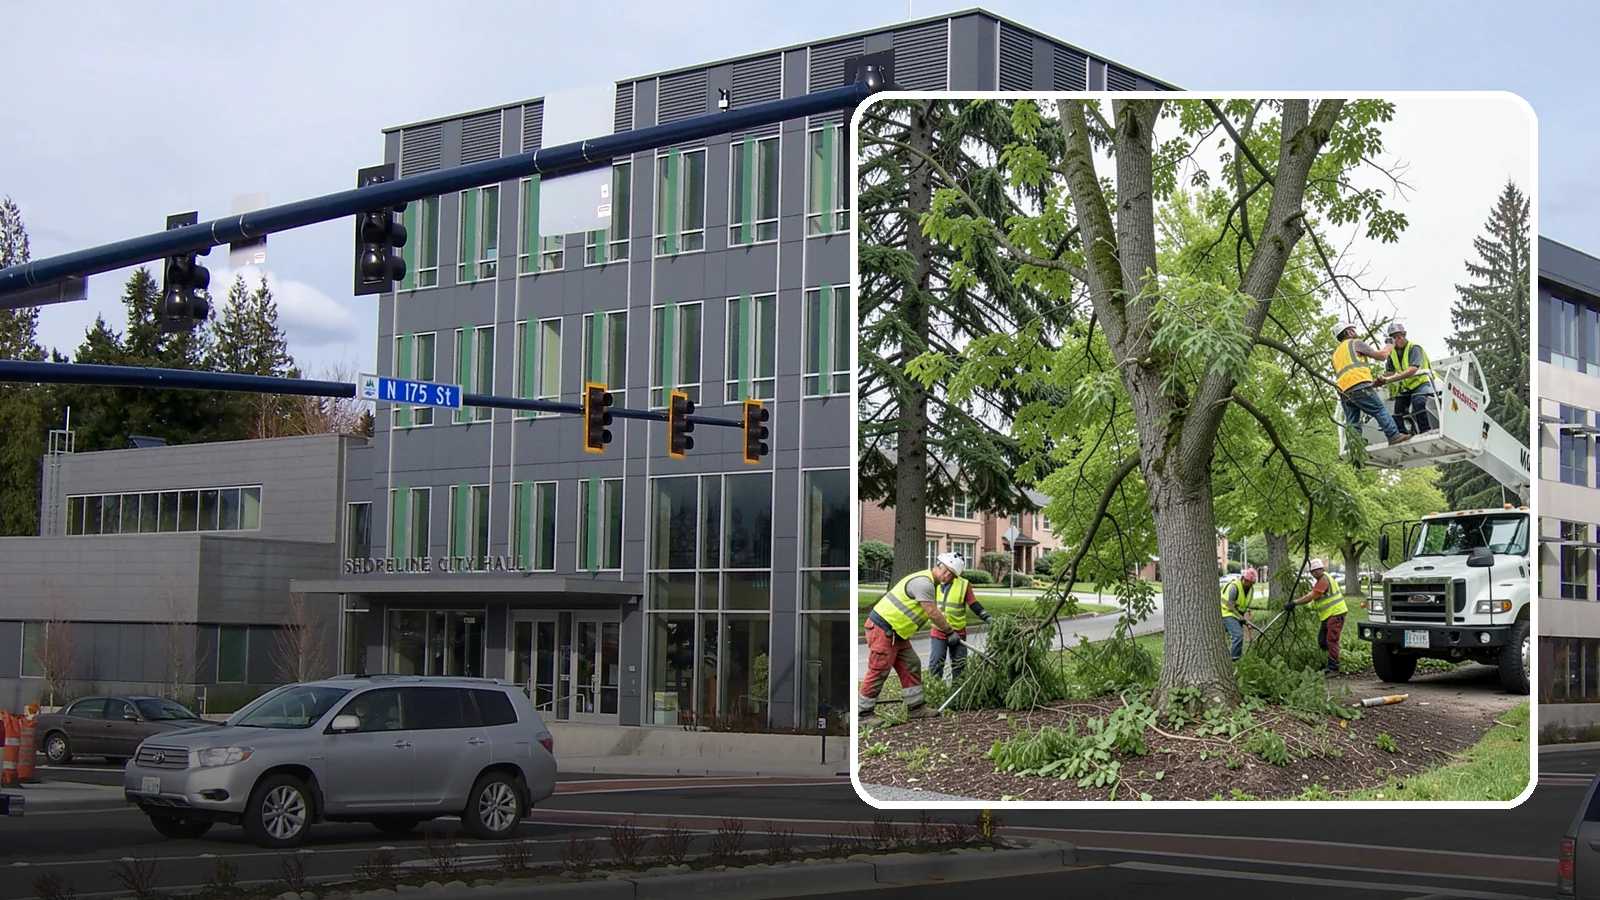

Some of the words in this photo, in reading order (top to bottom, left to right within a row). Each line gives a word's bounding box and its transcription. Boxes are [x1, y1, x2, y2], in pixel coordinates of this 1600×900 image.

[387, 380, 396, 400] N
[405, 382, 428, 403] 175
[436, 386, 452, 406] St
[343, 556, 432, 574] SHORELINE
[438, 556, 476, 572] CITY
[484, 555, 526, 572] HALL
